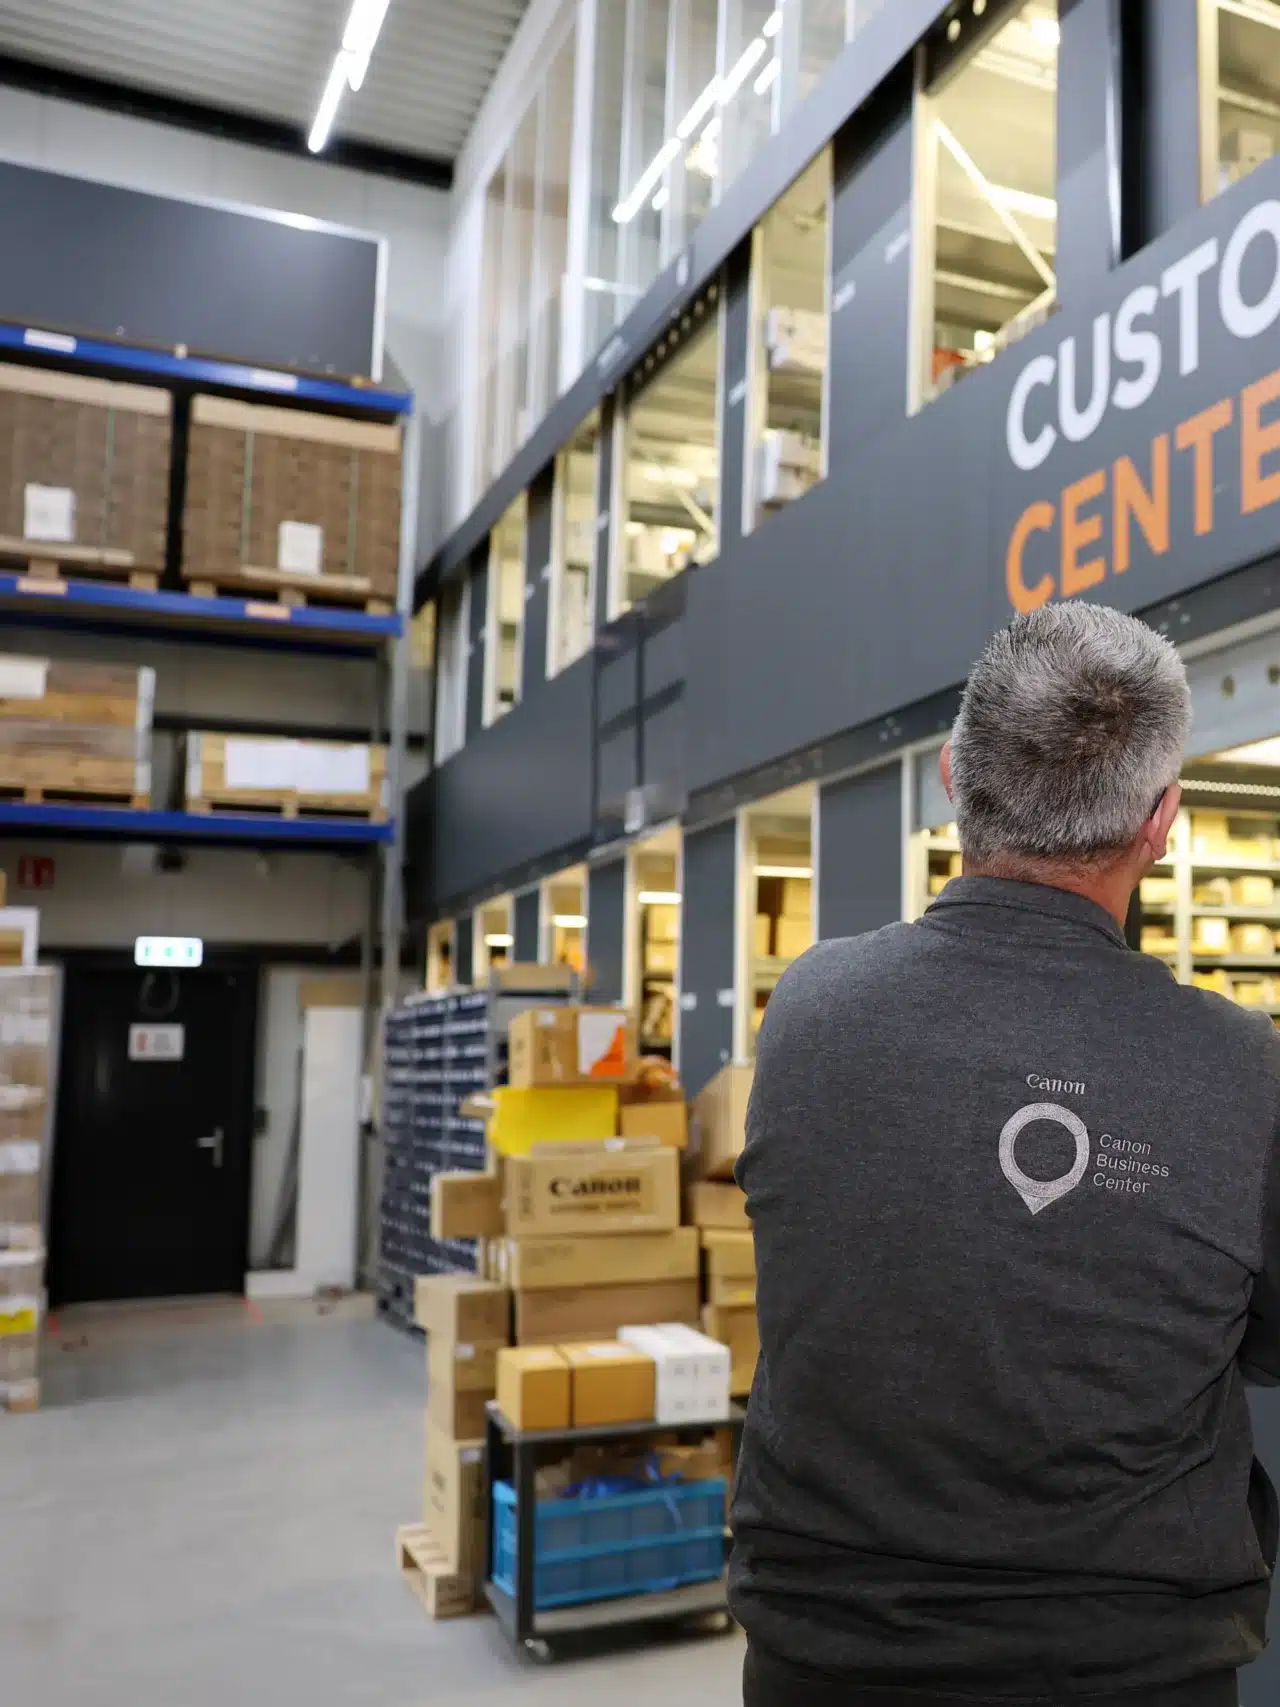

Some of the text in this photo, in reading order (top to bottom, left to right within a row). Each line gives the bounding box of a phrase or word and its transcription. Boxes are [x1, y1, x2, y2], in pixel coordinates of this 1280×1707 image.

[1026, 1073, 1086, 1095] Canon
[1099, 1134, 1151, 1155] Canon
[1096, 1153, 1170, 1177] Business
[549, 1176, 641, 1196] Canon
[1093, 1172, 1151, 1193] Center
